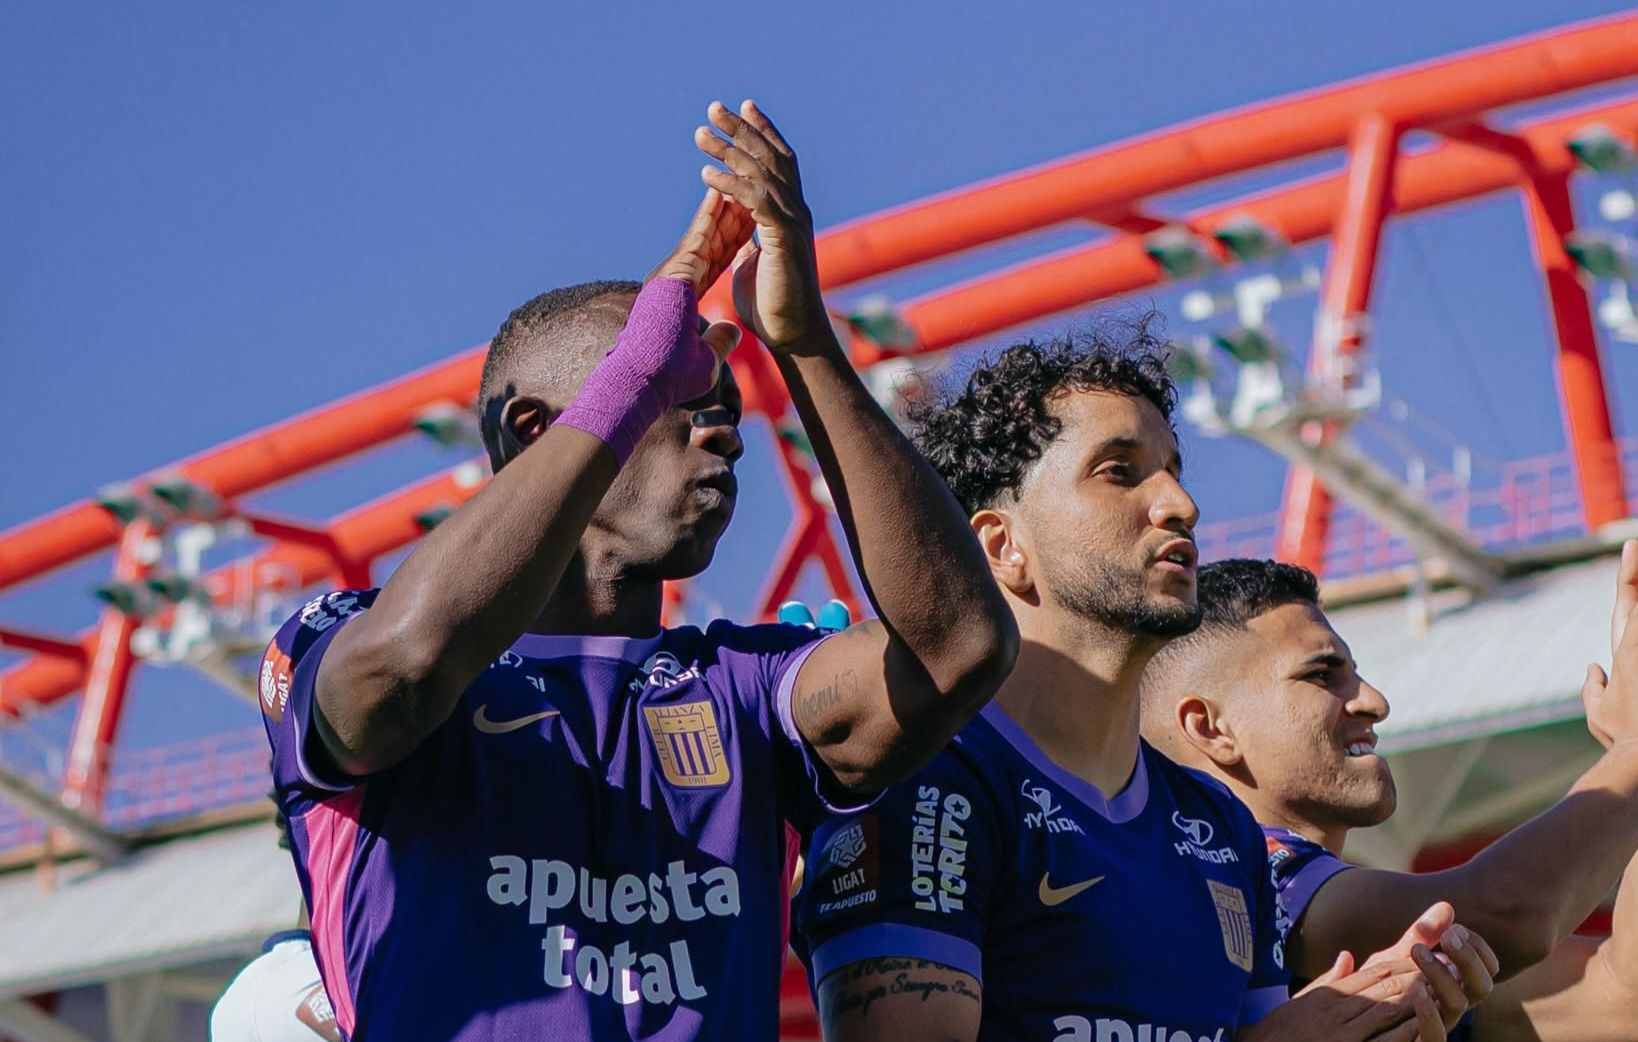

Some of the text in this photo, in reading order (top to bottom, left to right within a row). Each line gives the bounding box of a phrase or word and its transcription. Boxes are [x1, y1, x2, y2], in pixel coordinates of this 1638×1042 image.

[486, 855, 741, 925] apuesta
[938, 793, 972, 914] TORITO
[541, 924, 708, 1005] total
